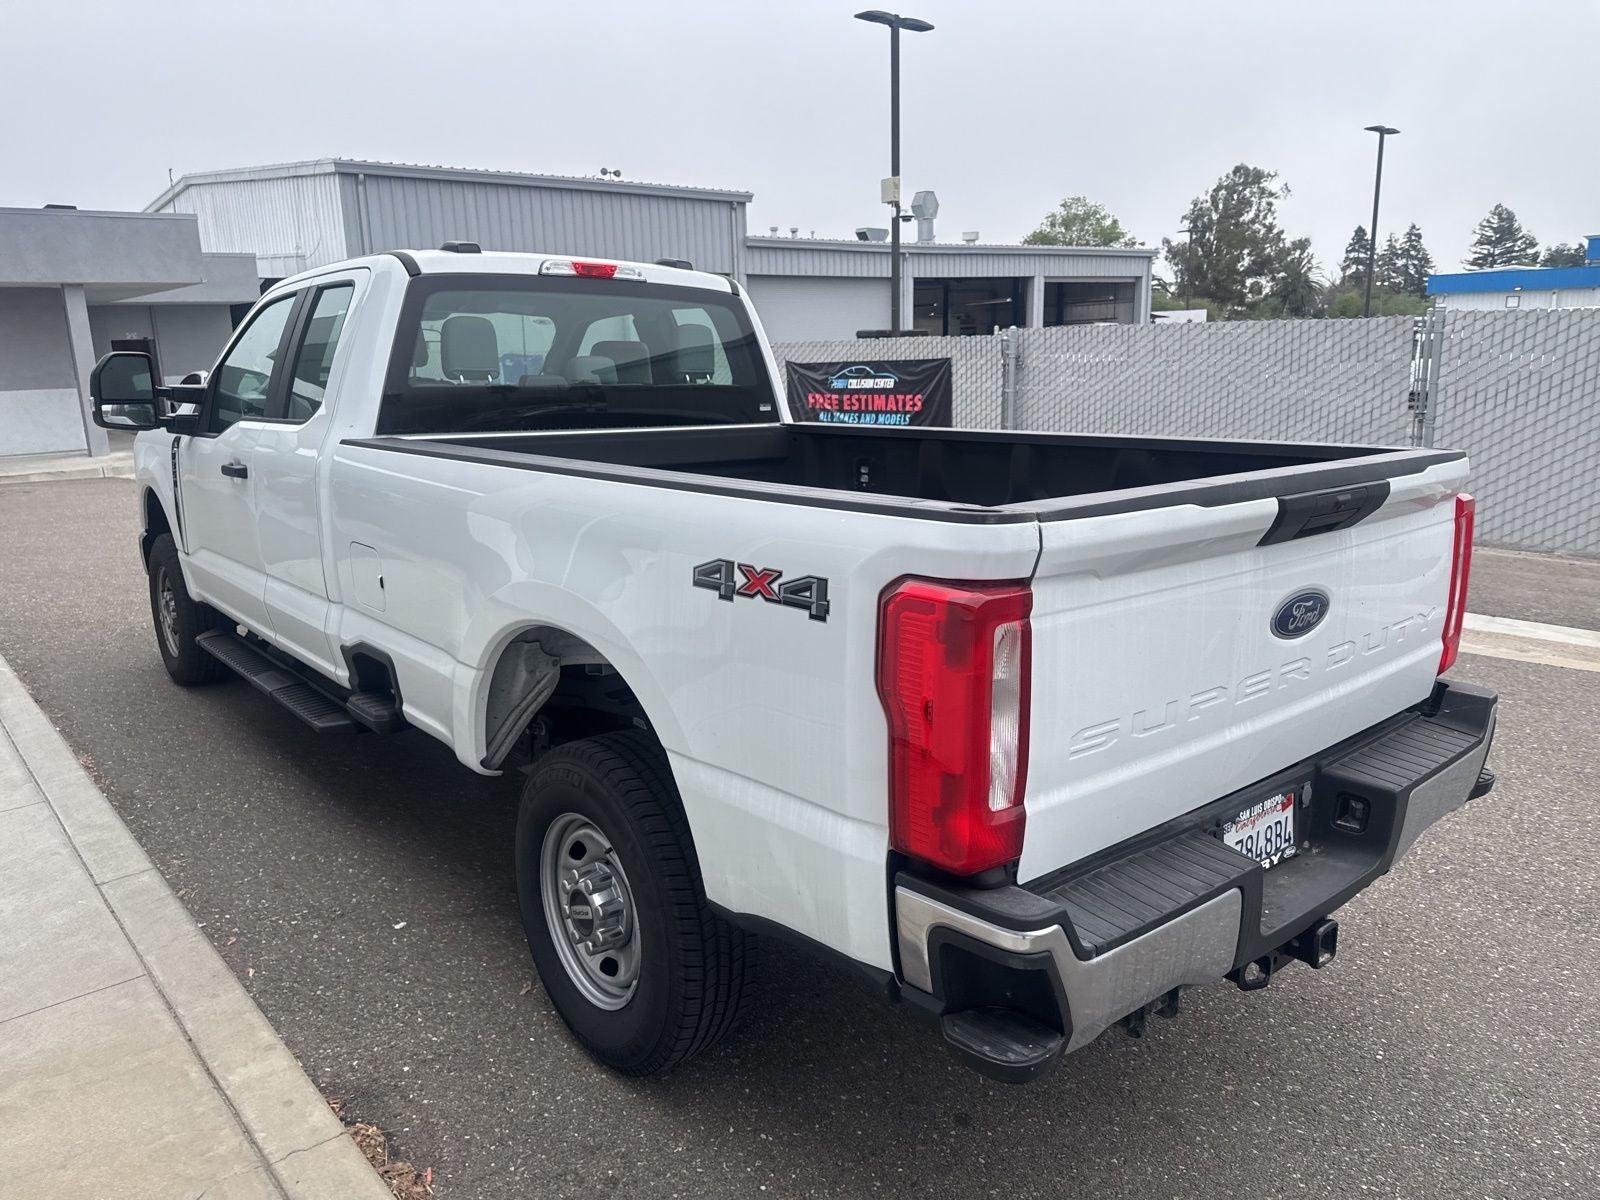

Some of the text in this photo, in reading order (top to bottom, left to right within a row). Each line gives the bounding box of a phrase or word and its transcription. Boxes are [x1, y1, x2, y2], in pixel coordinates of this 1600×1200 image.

[808, 393, 923, 412] FREE ESTIMATES
[819, 411, 831, 422] ALL
[859, 413, 876, 424] AND
[877, 413, 910, 425] MODELS
[1288, 600, 1321, 630] Ford
[1069, 606, 1437, 760] SUPER DUTY
[1239, 808, 1251, 821] SAN
[1251, 802, 1263, 816] LUIS
